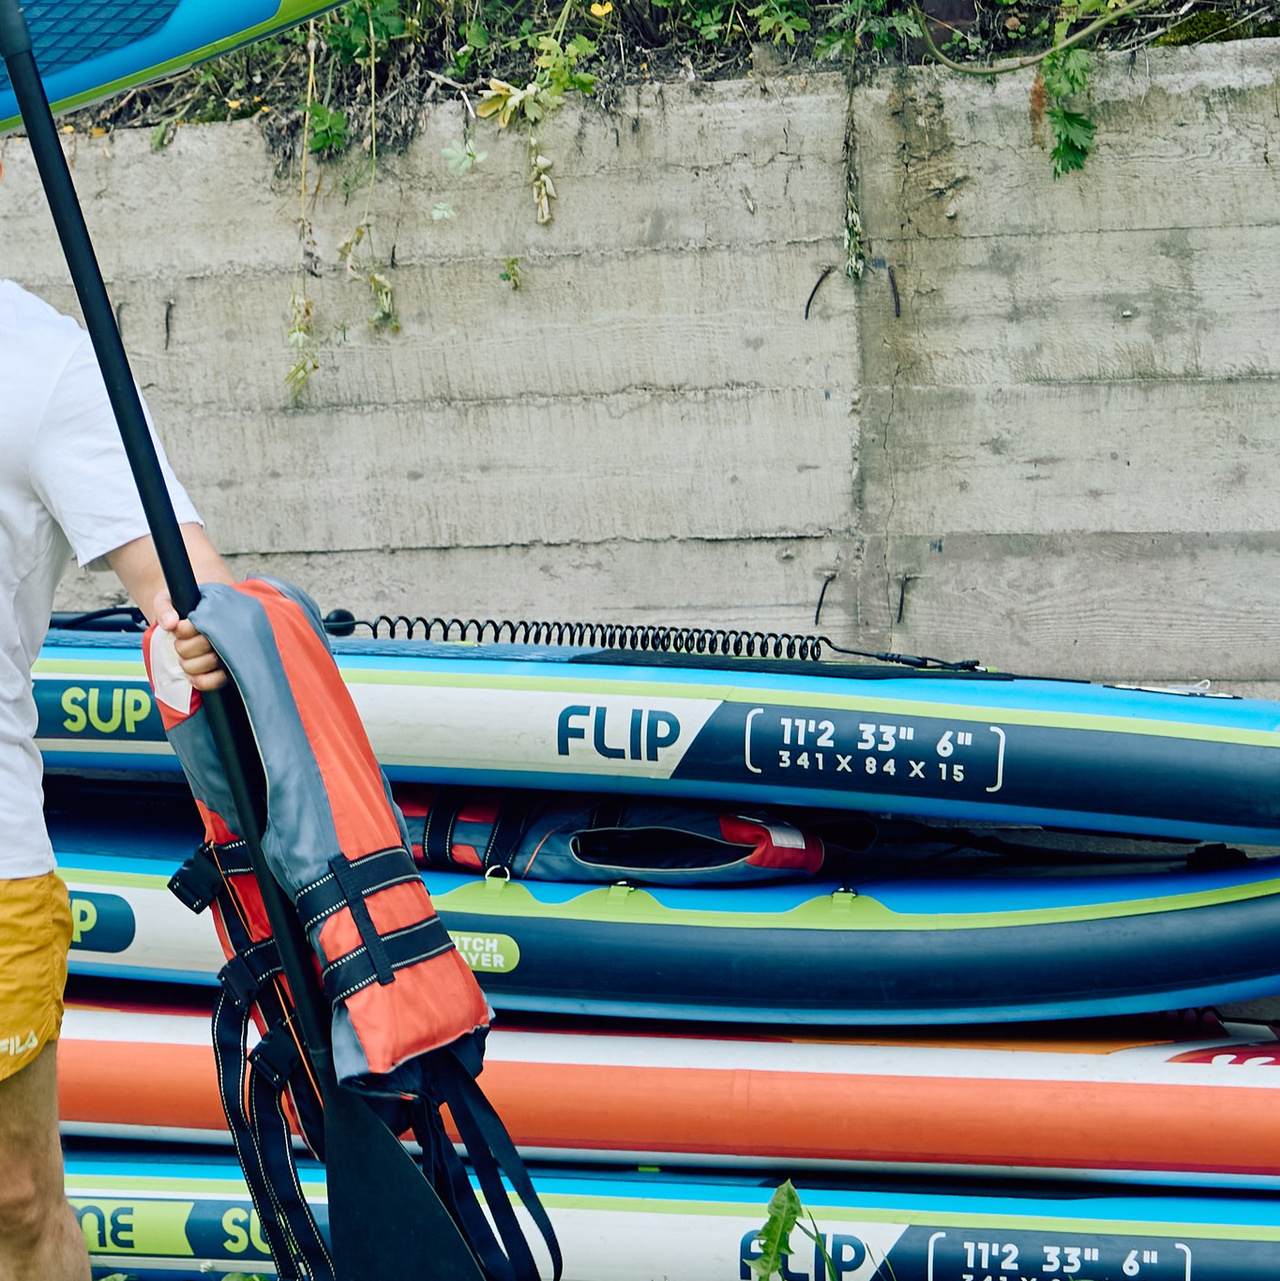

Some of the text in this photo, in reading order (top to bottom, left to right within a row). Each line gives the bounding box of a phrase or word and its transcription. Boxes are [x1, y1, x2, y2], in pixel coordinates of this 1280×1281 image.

[61, 686, 152, 733] SUP
[557, 705, 681, 762] FLIP
[780, 718, 973, 758] 11'2 33" 6"
[963, 1241, 1158, 1276] 11'2 33" 6"
